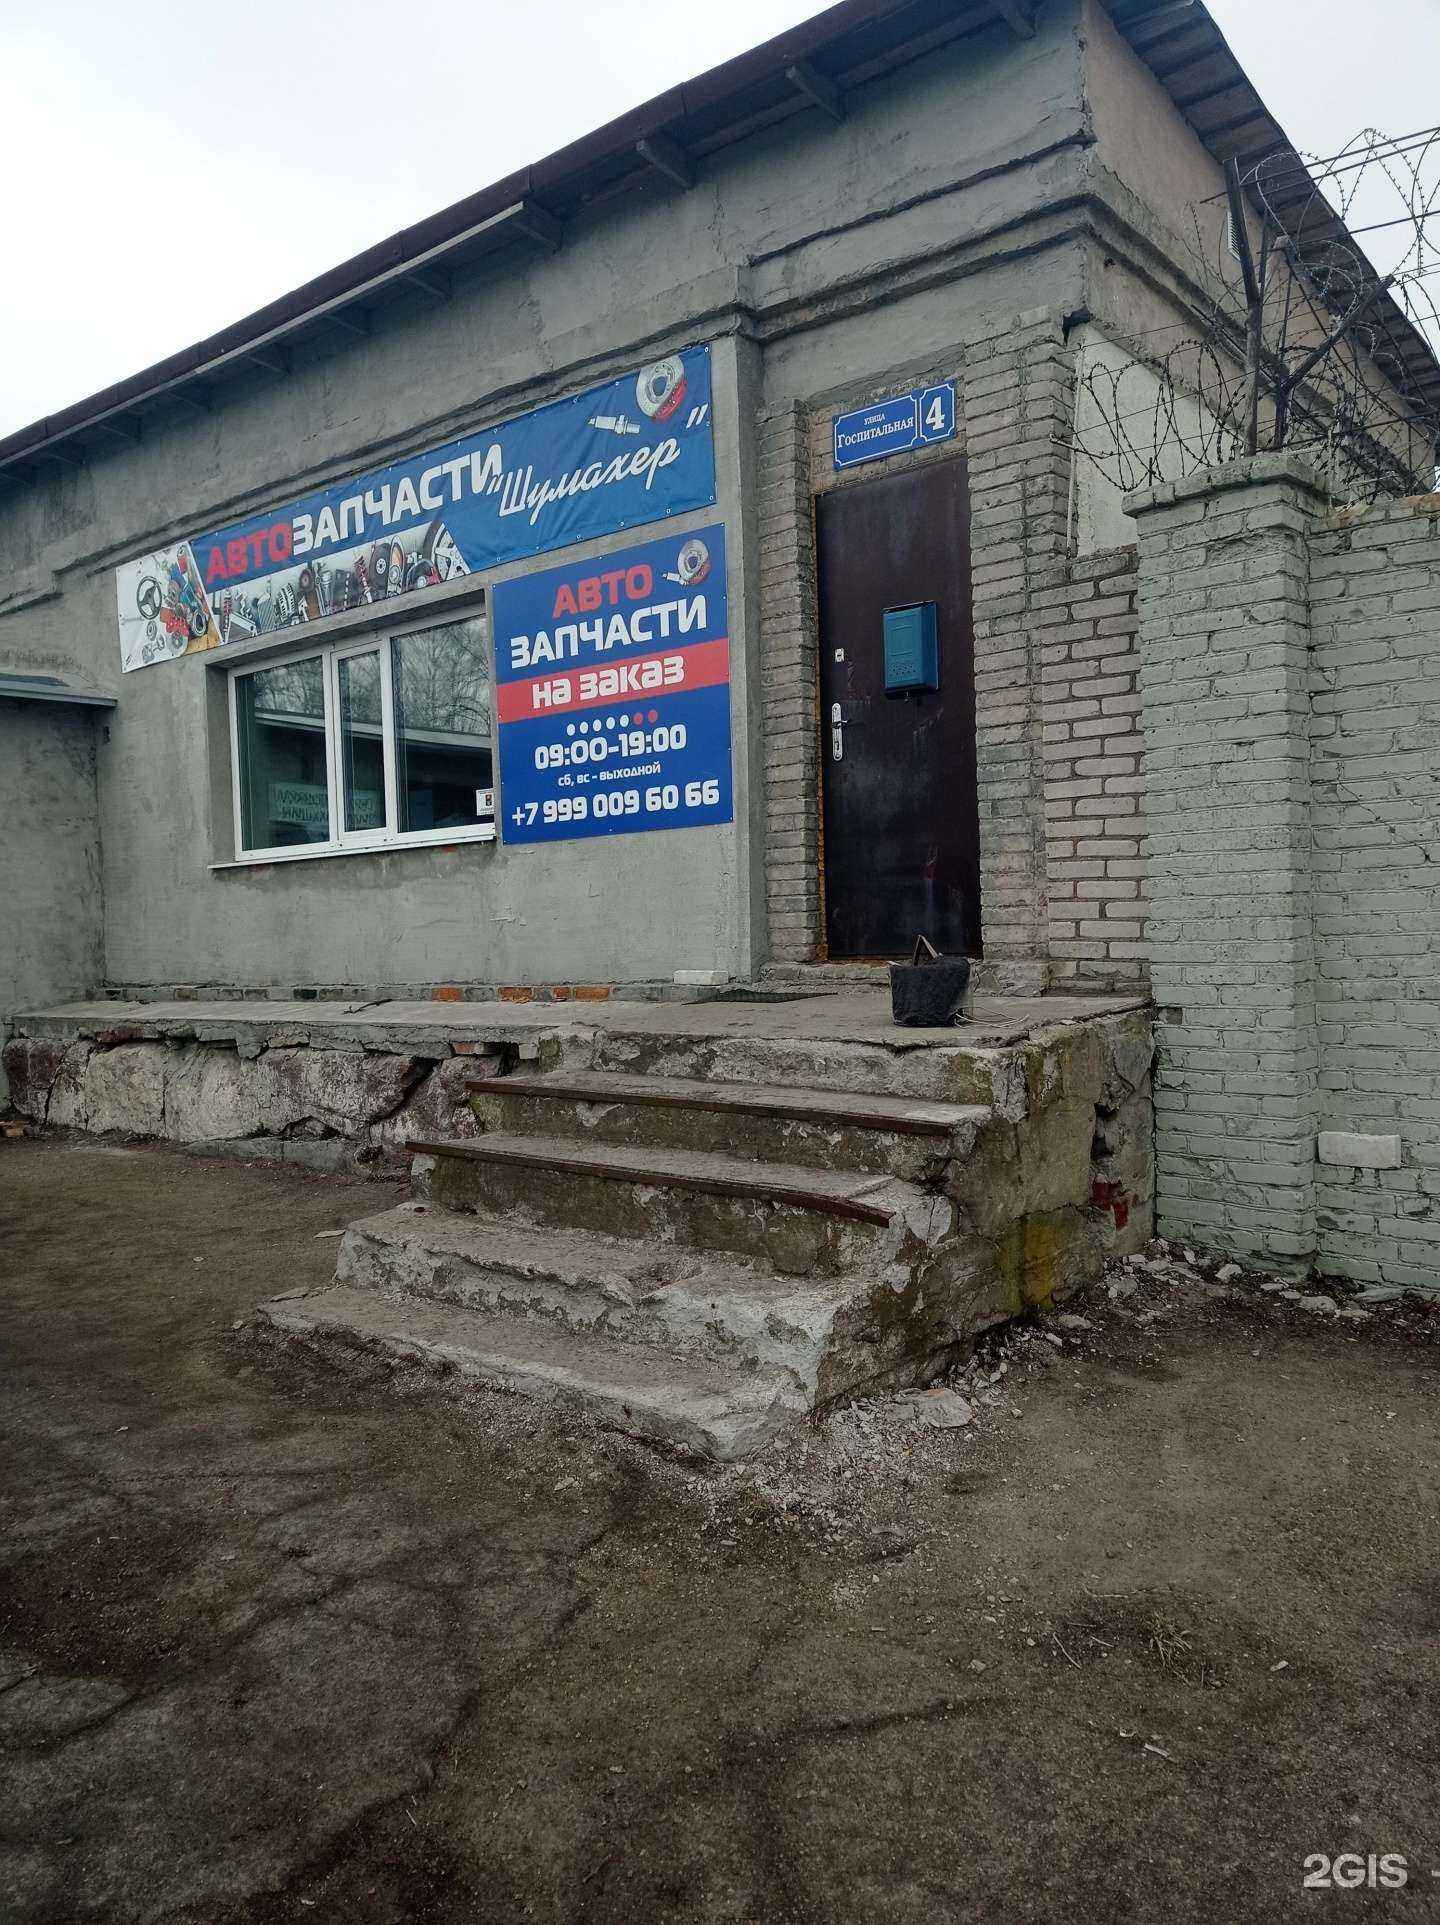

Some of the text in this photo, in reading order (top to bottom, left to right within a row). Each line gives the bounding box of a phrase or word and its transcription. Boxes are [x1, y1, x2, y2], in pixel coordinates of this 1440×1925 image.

[925, 396, 946, 430] 4
[552, 563, 653, 619] АВТО
[510, 594, 708, 669] ЗАПЧАСТИ
[532, 677, 572, 709] на
[534, 724, 688, 770] 09:00-19:00
[557, 772, 576, 788] сб,
[576, 771, 590, 784] вс
[599, 760, 661, 781] выходной
[511, 802, 539, 827] +7
[543, 796, 588, 824] 999
[593, 789, 640, 816] 009
[645, 784, 679, 811] 60
[685, 779, 720, 806] 66
